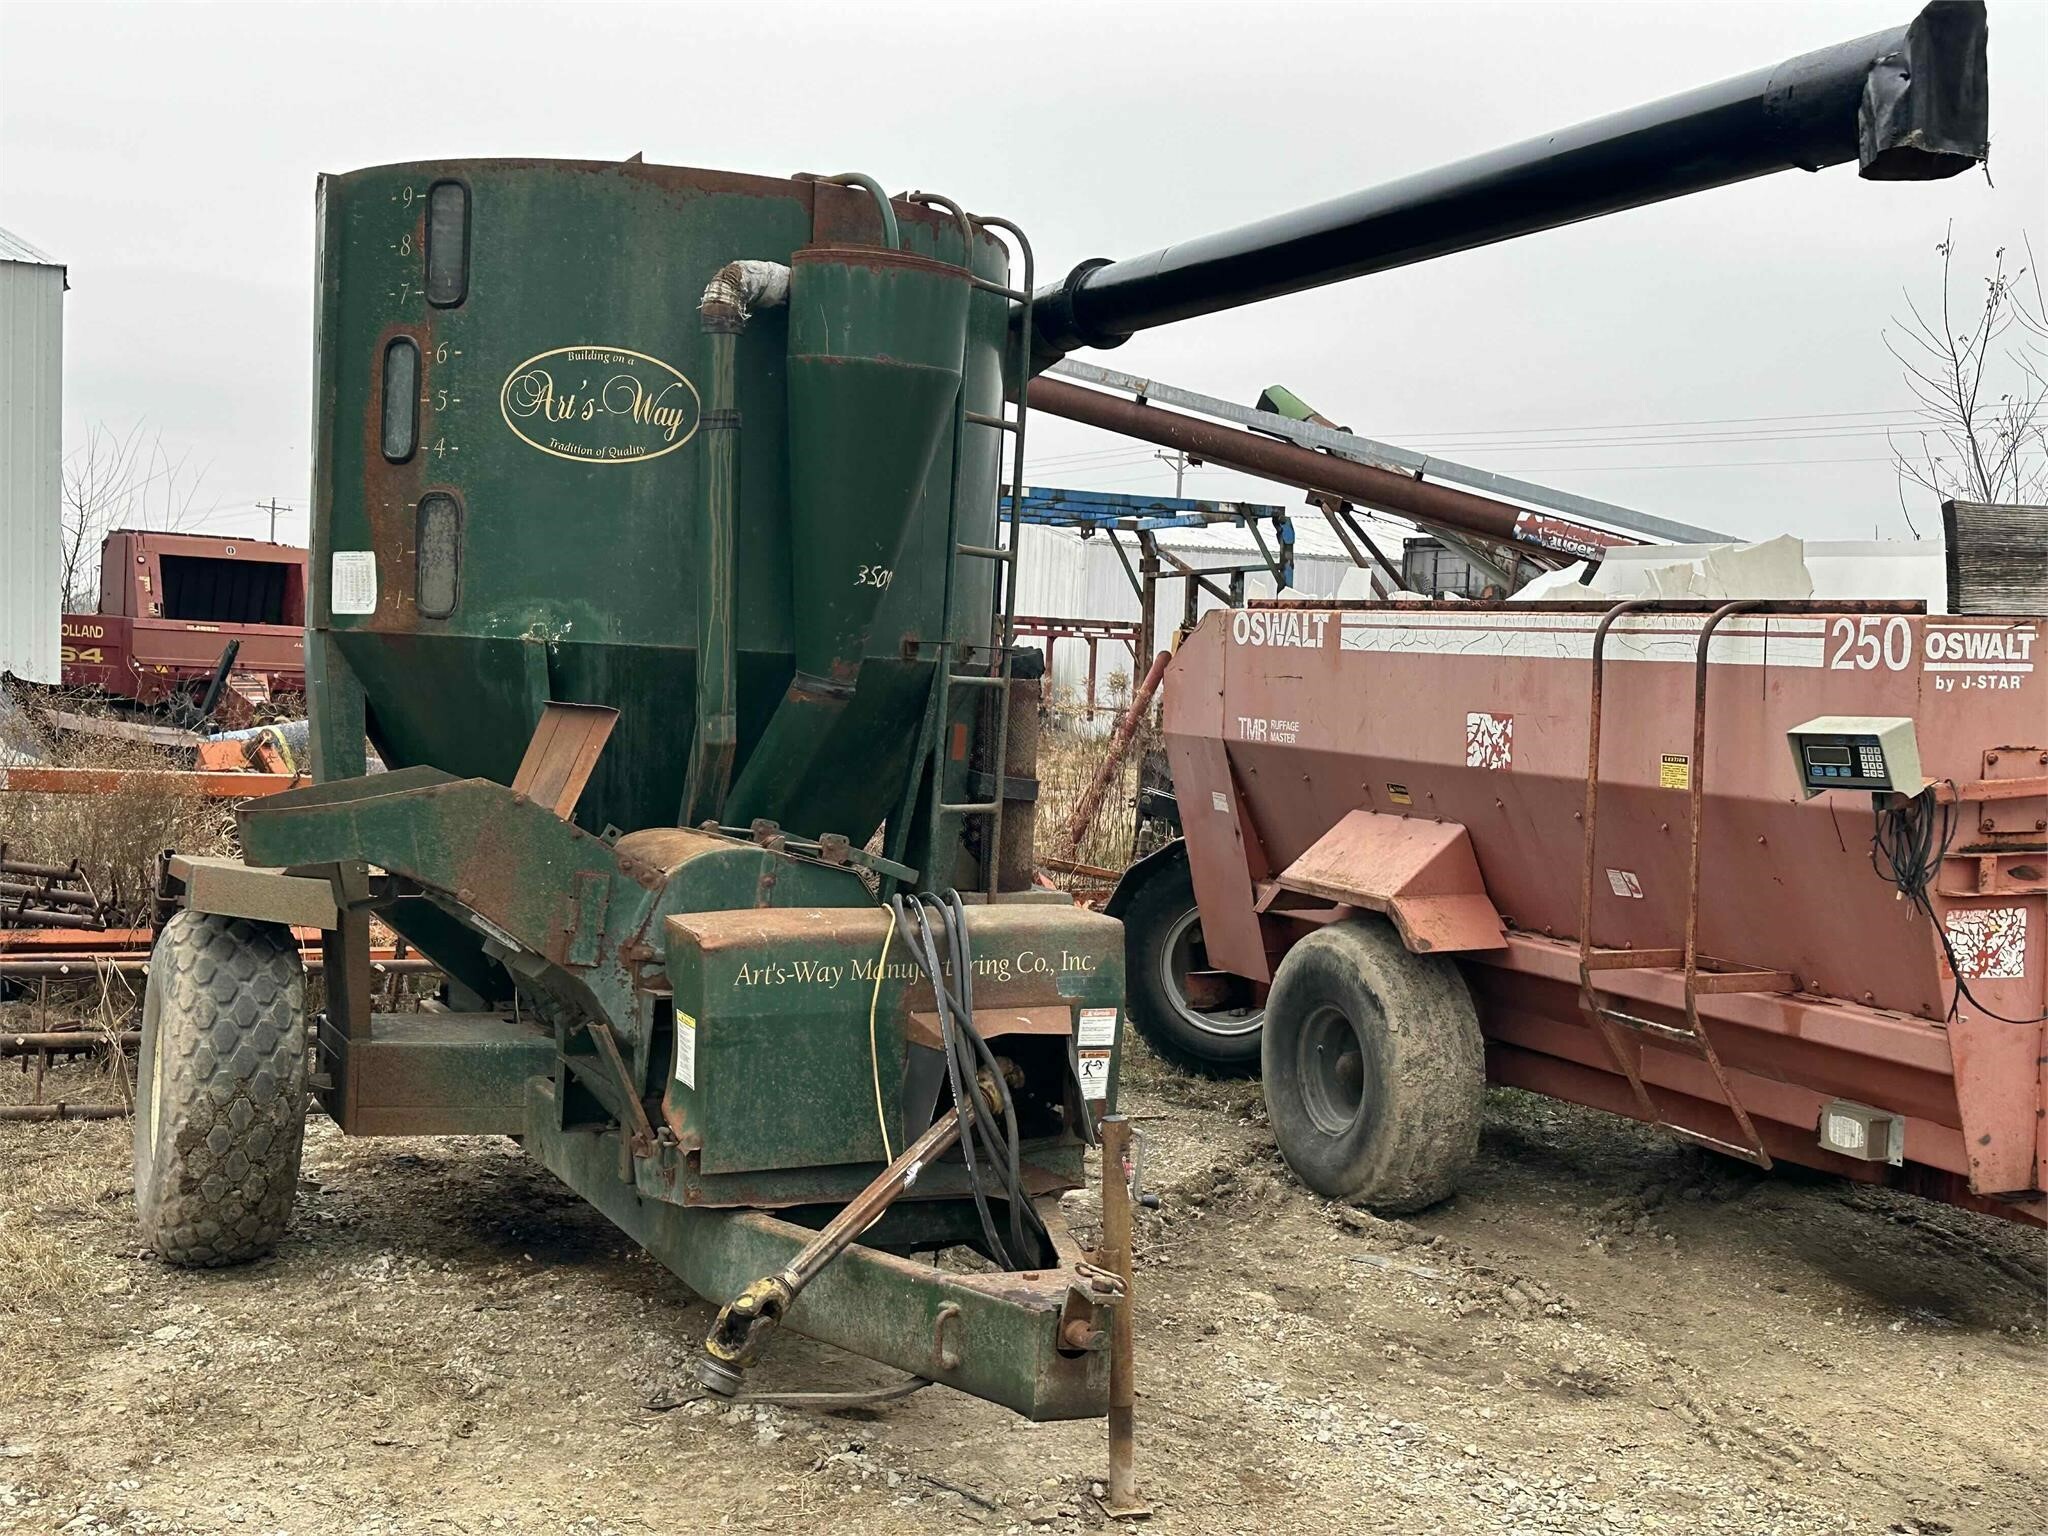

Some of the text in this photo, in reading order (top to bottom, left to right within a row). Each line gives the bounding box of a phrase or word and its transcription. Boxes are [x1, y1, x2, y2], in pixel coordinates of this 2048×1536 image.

[403, 186, 413, 209] 9
[401, 234, 411, 256] 8
[401, 283, 410, 304] 7
[436, 341, 449, 364] 6
[568, 350, 635, 366] Building on a
[435, 390, 448, 411] 5
[507, 370, 684, 441] Art's-Way
[433, 437, 446, 459] 4
[550, 437, 646, 458] Tradition of Quality
[1233, 611, 1330, 648] OSWALT
[1831, 616, 1912, 671] 250
[1925, 631, 2036, 660] OSWALT
[1935, 675, 2021, 692] by J-STAR
[1238, 717, 1267, 742] TMR
[1270, 732, 1296, 743] MASTER
[734, 950, 1096, 988] Art's-Way Manuftring Co., Inc.
